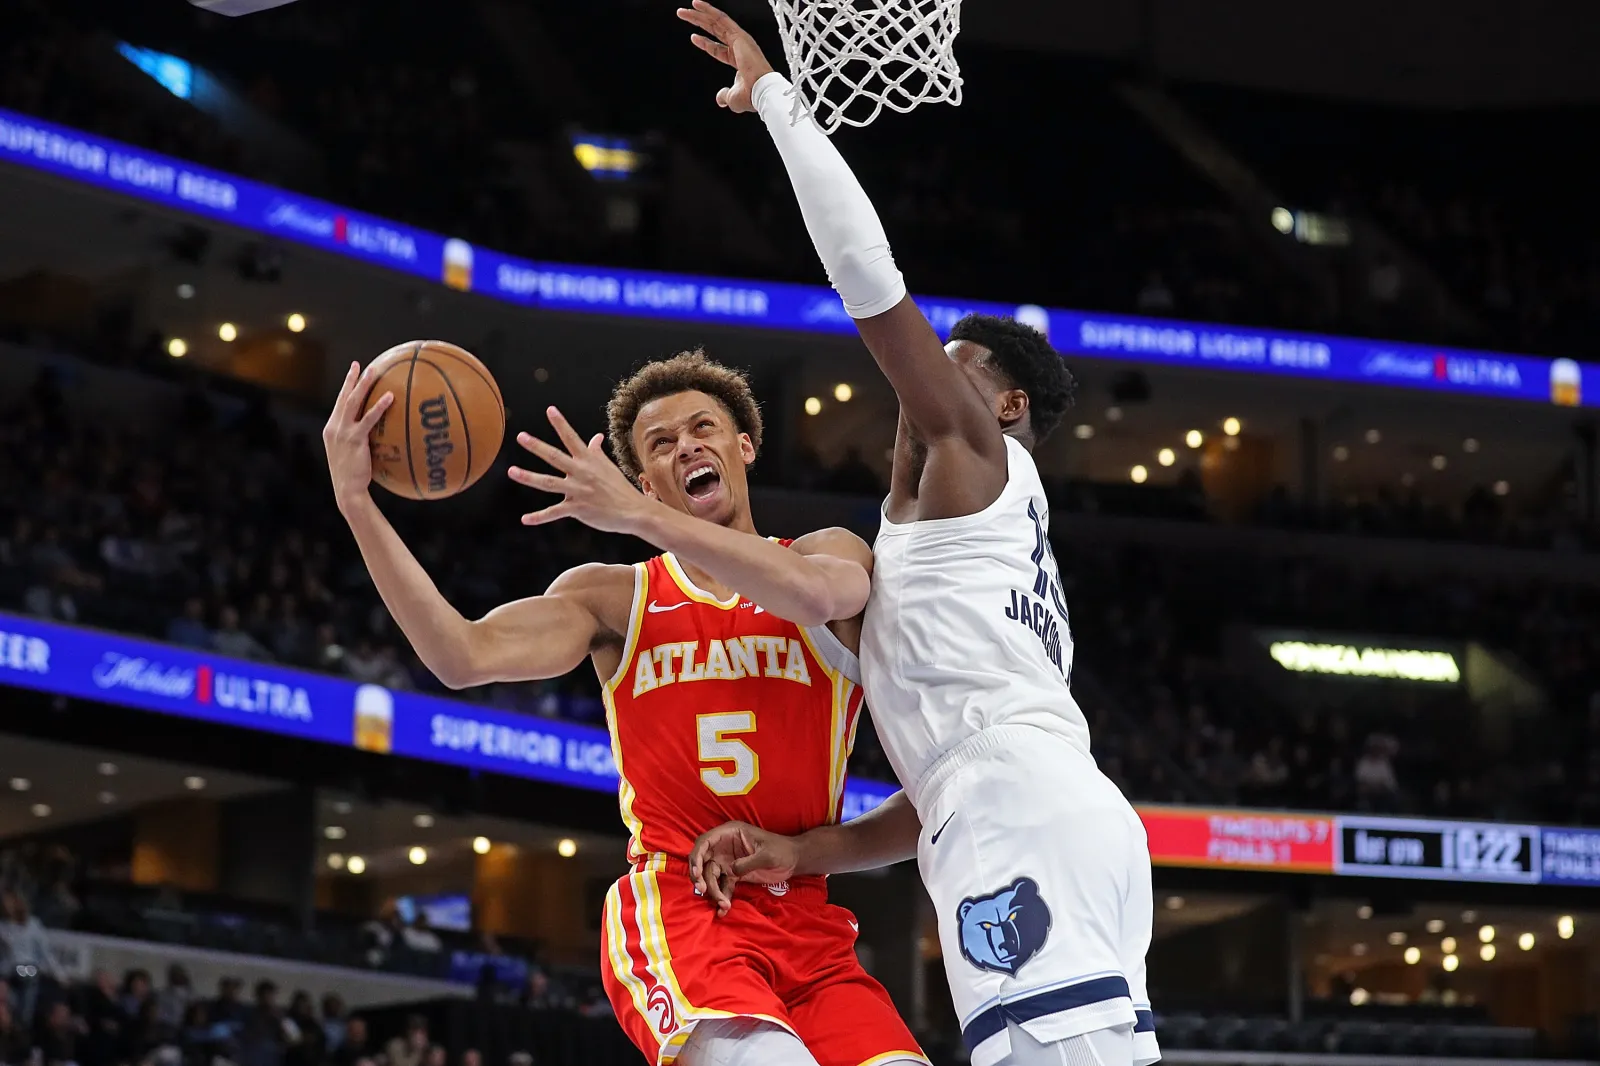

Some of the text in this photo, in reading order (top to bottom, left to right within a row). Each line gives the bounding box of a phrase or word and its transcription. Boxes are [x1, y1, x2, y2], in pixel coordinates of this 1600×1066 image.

[498, 264, 620, 303] SUPERIOR
[623, 280, 696, 311] LIGHT
[702, 285, 768, 316] BEER
[1080, 320, 1196, 357] SUPERIOR
[419, 394, 453, 493] Wilson
[740, 601, 753, 609] the
[1005, 588, 1064, 678] JACKSON
[215, 672, 313, 722] ULTRA
[632, 636, 811, 699] ATLANTA
[431, 714, 619, 777] SUPERIOR LIG
[696, 710, 760, 797] 5
